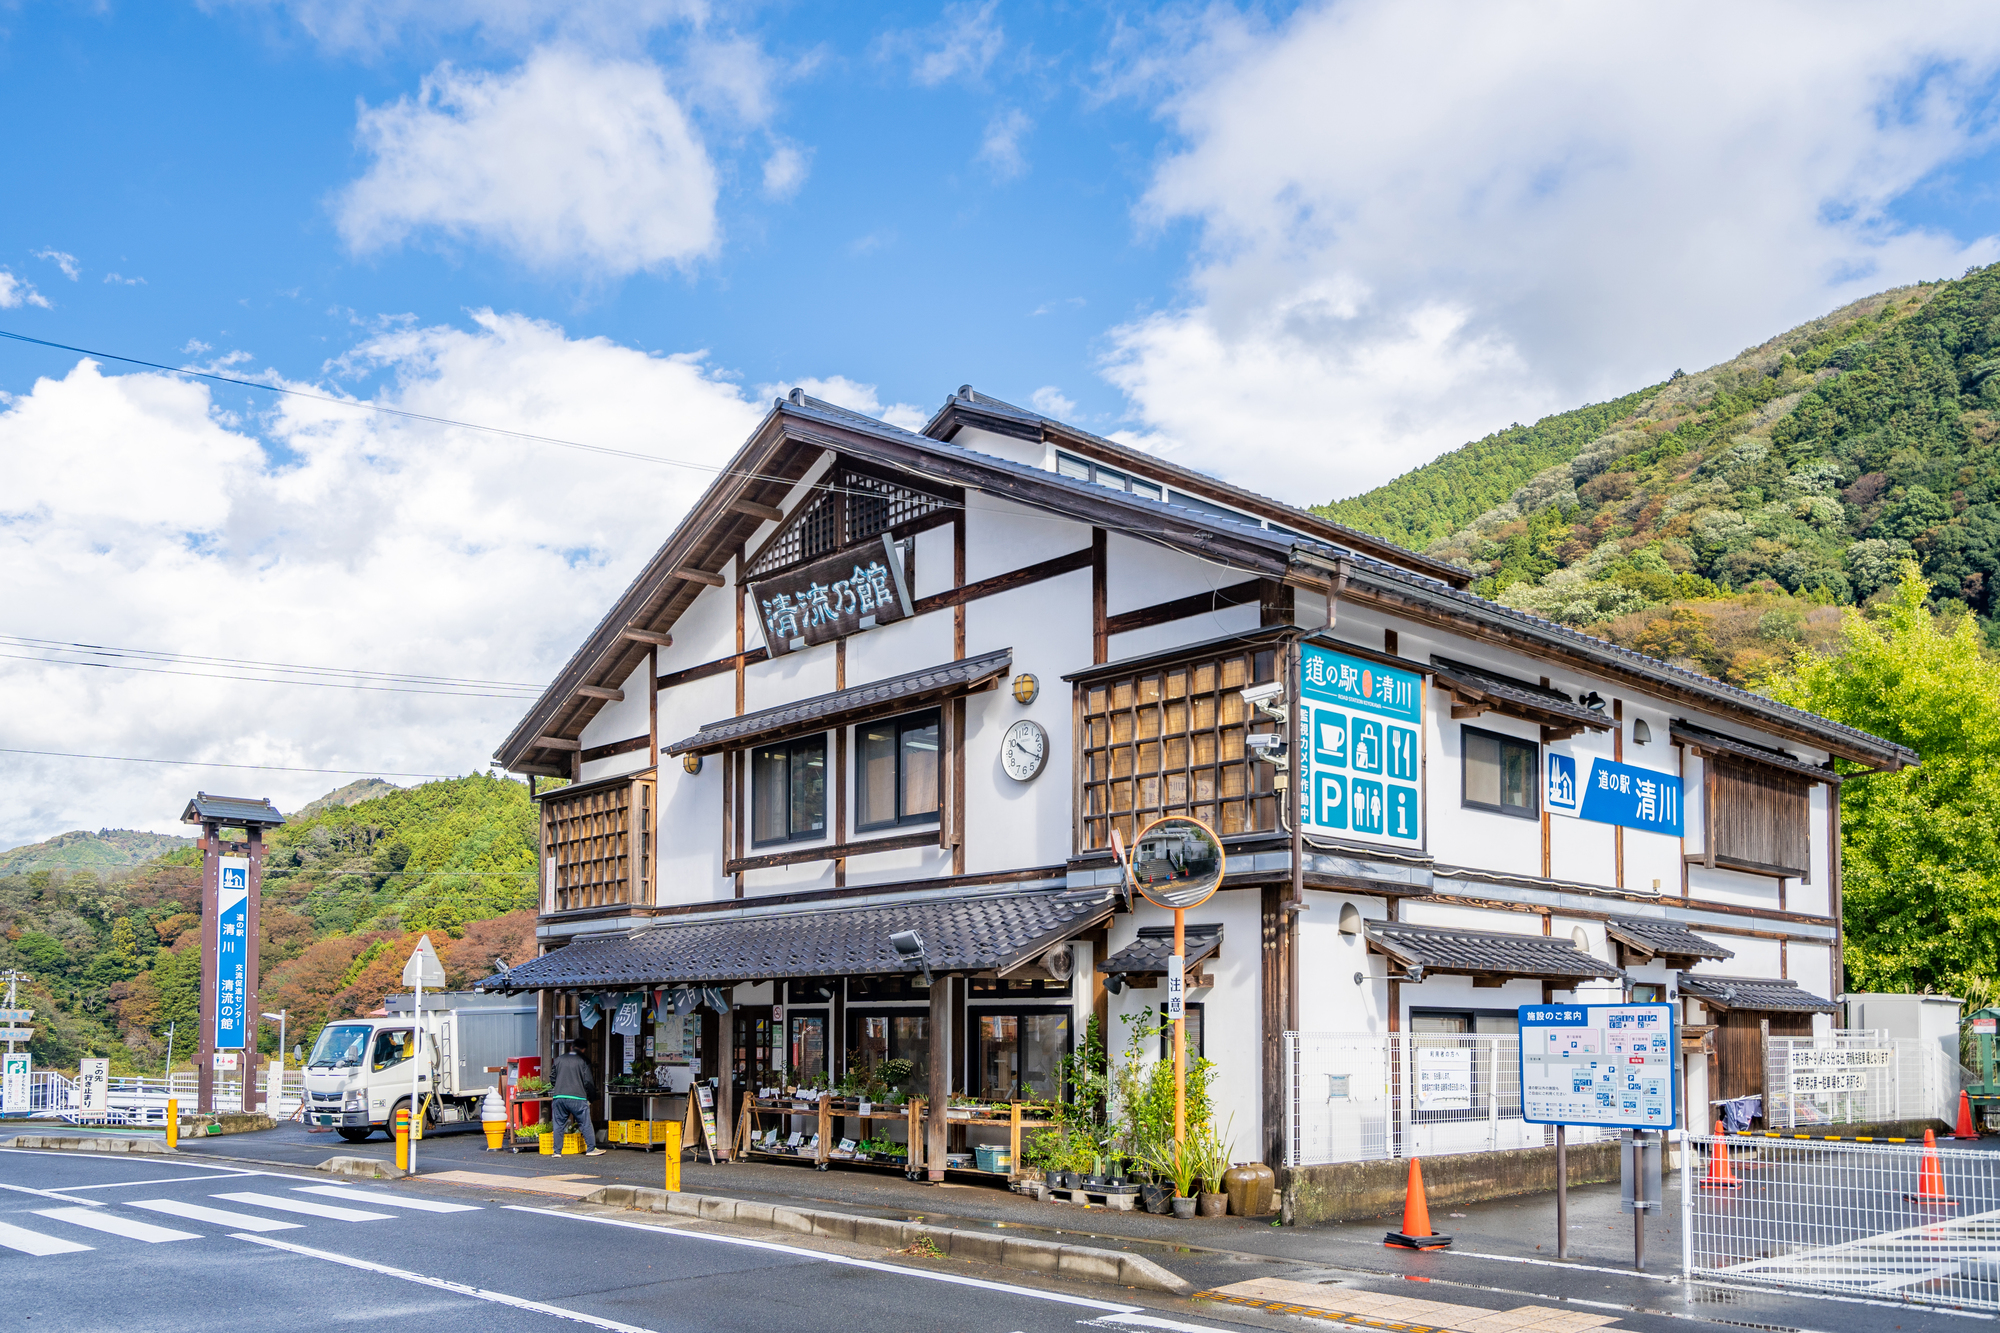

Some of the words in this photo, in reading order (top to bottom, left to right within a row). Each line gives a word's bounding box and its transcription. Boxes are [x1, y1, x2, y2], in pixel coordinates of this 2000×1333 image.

[762, 561, 893, 638] 清流乃館
[1305, 655, 1361, 696] 道の駅
[1376, 675, 1412, 709] 清川
[1338, 693, 1349, 701] ROAD
[1022, 727, 1029, 736] 12
[1035, 734, 1040, 742] 2
[1008, 750, 1013, 758] 9
[1009, 739, 1017, 748] 10
[1037, 743, 1042, 753] 3
[1011, 758, 1015, 767] 8
[1016, 765, 1021, 774] 7
[1023, 766, 1027, 775] 6
[1030, 762, 1035, 771] 5
[1300, 708, 1309, 820] 監視カメラ作動中
[1322, 777, 1342, 823] P
[1598, 769, 1631, 795] 道の駅
[1635, 778, 1677, 826] 清川
[236, 913, 244, 937] 道の駅
[222, 923, 235, 953] 清川
[221, 979, 234, 1030] 清流の館
[235, 964, 243, 1026] 交流促進センター
[1170, 977, 1181, 1013] 注意
[1527, 1011, 1582, 1021] 施設のご案内
[94, 1062, 104, 1083] この先
[84, 1074, 94, 1109] 行き止まり
